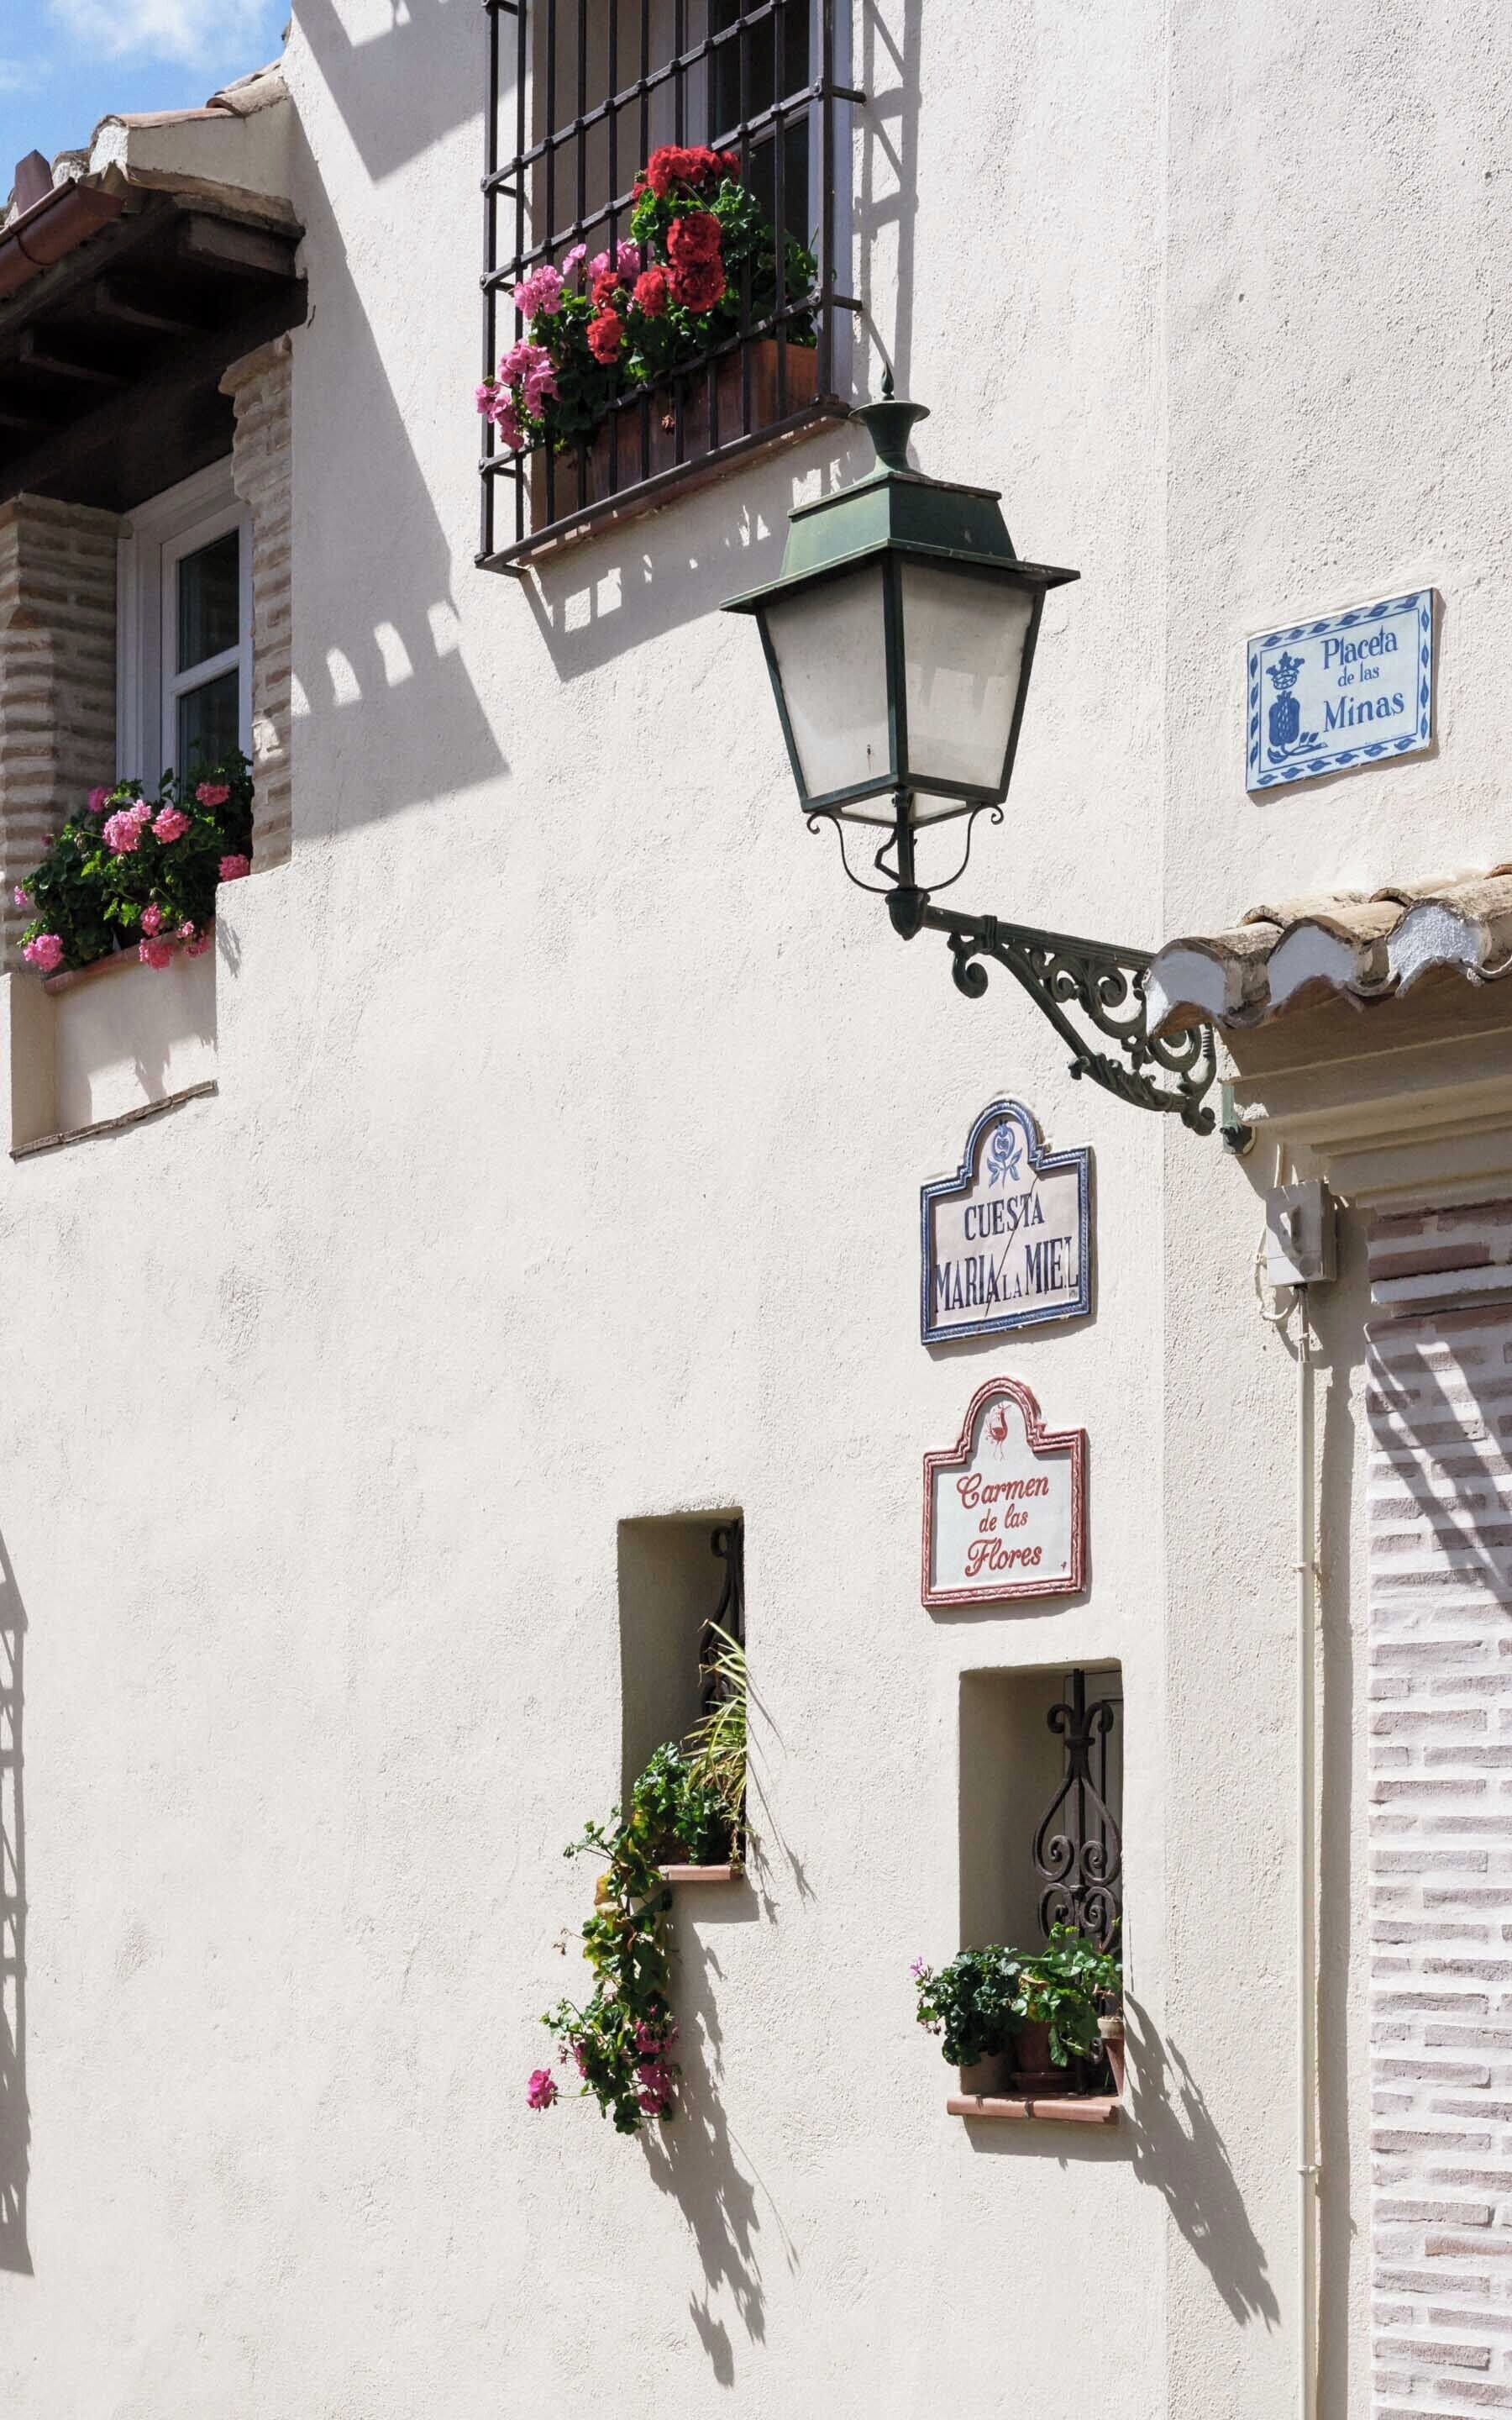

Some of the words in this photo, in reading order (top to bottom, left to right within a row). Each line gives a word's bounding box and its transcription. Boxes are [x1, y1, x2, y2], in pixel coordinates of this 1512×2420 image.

[1320, 625, 1399, 670] Placeta
[1338, 667, 1355, 687] de
[1360, 661, 1379, 682] las
[1323, 692, 1405, 733] Minas
[964, 1192, 1045, 1241] CUESTA
[934, 1253, 1000, 1313] MARIA
[1003, 1272, 1022, 1302] LA
[1025, 1236, 1079, 1296] MIEL
[956, 1472, 1049, 1509] Carmen
[979, 1508, 997, 1534] de
[1004, 1503, 1028, 1529] las
[964, 1537, 1042, 1577] Flores
